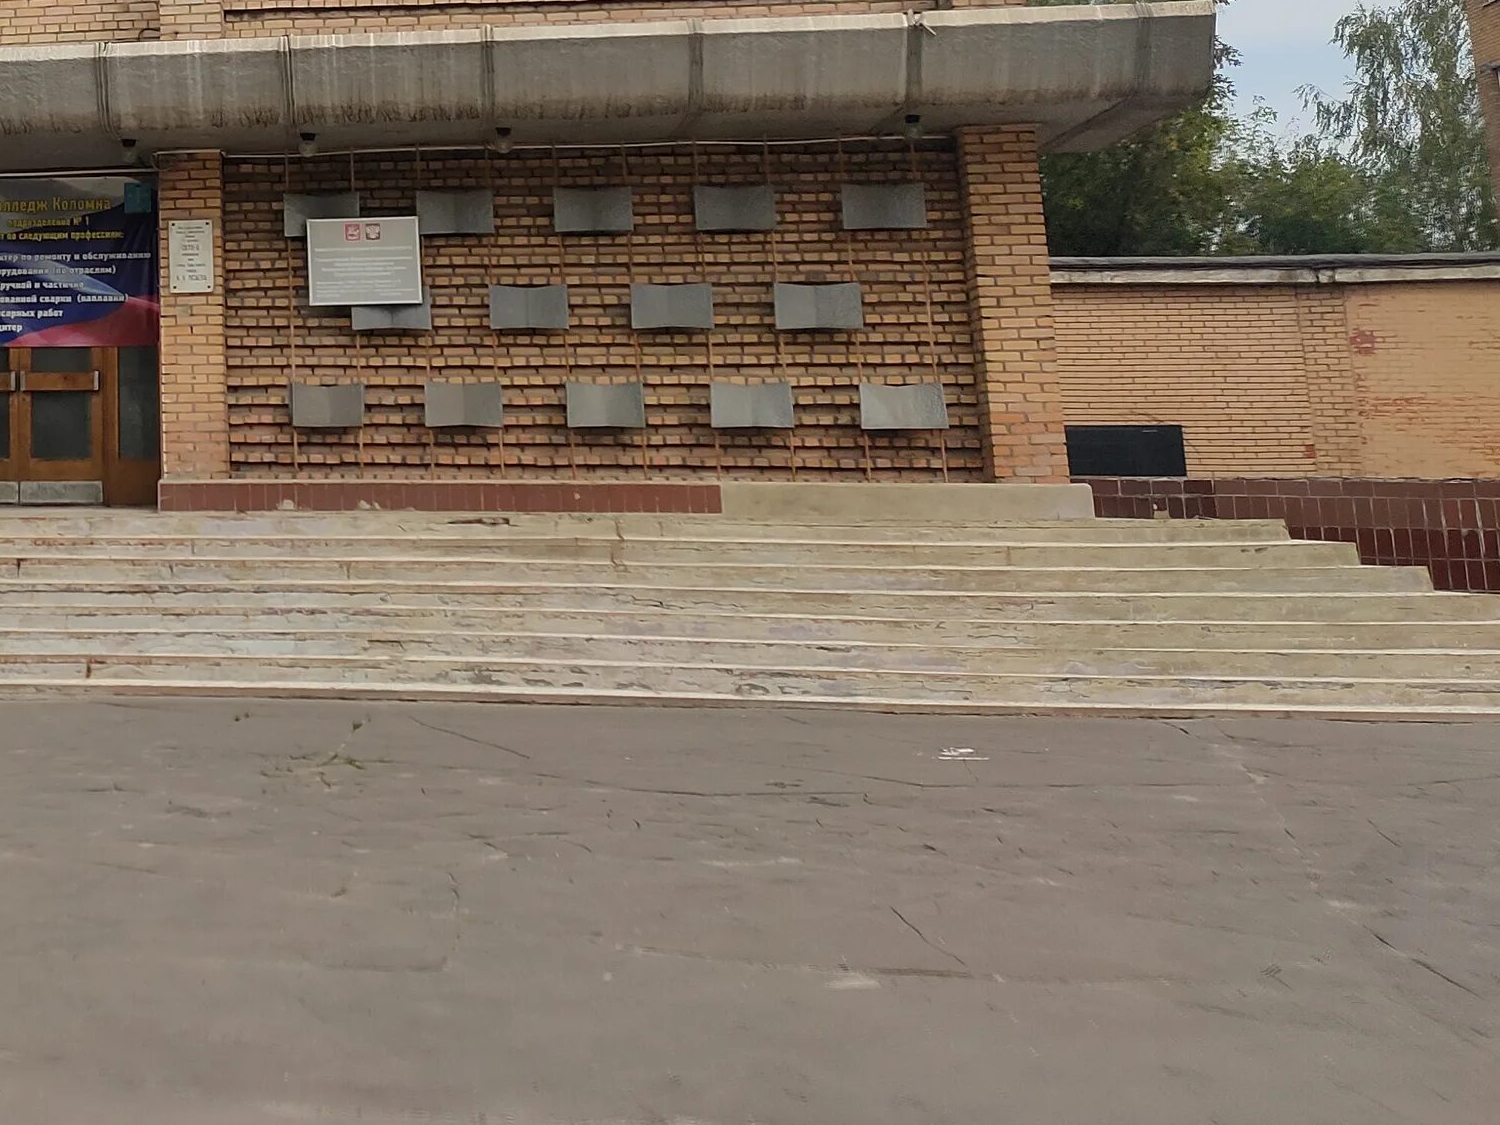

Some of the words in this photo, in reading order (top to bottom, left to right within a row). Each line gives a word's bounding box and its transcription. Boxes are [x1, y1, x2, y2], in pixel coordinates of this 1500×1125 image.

[52, 196, 112, 211] Коломна
[85, 216, 89, 225] 1
[19, 232, 68, 242] следующим
[71, 230, 124, 241] профессиям:
[35, 253, 71, 262] ремонту
[82, 252, 151, 261] обслуживанию
[69, 265, 116, 275] отраслям)
[40, 296, 72, 304] сварки
[77, 293, 128, 302] (наплавки)
[37, 308, 63, 319] работ
